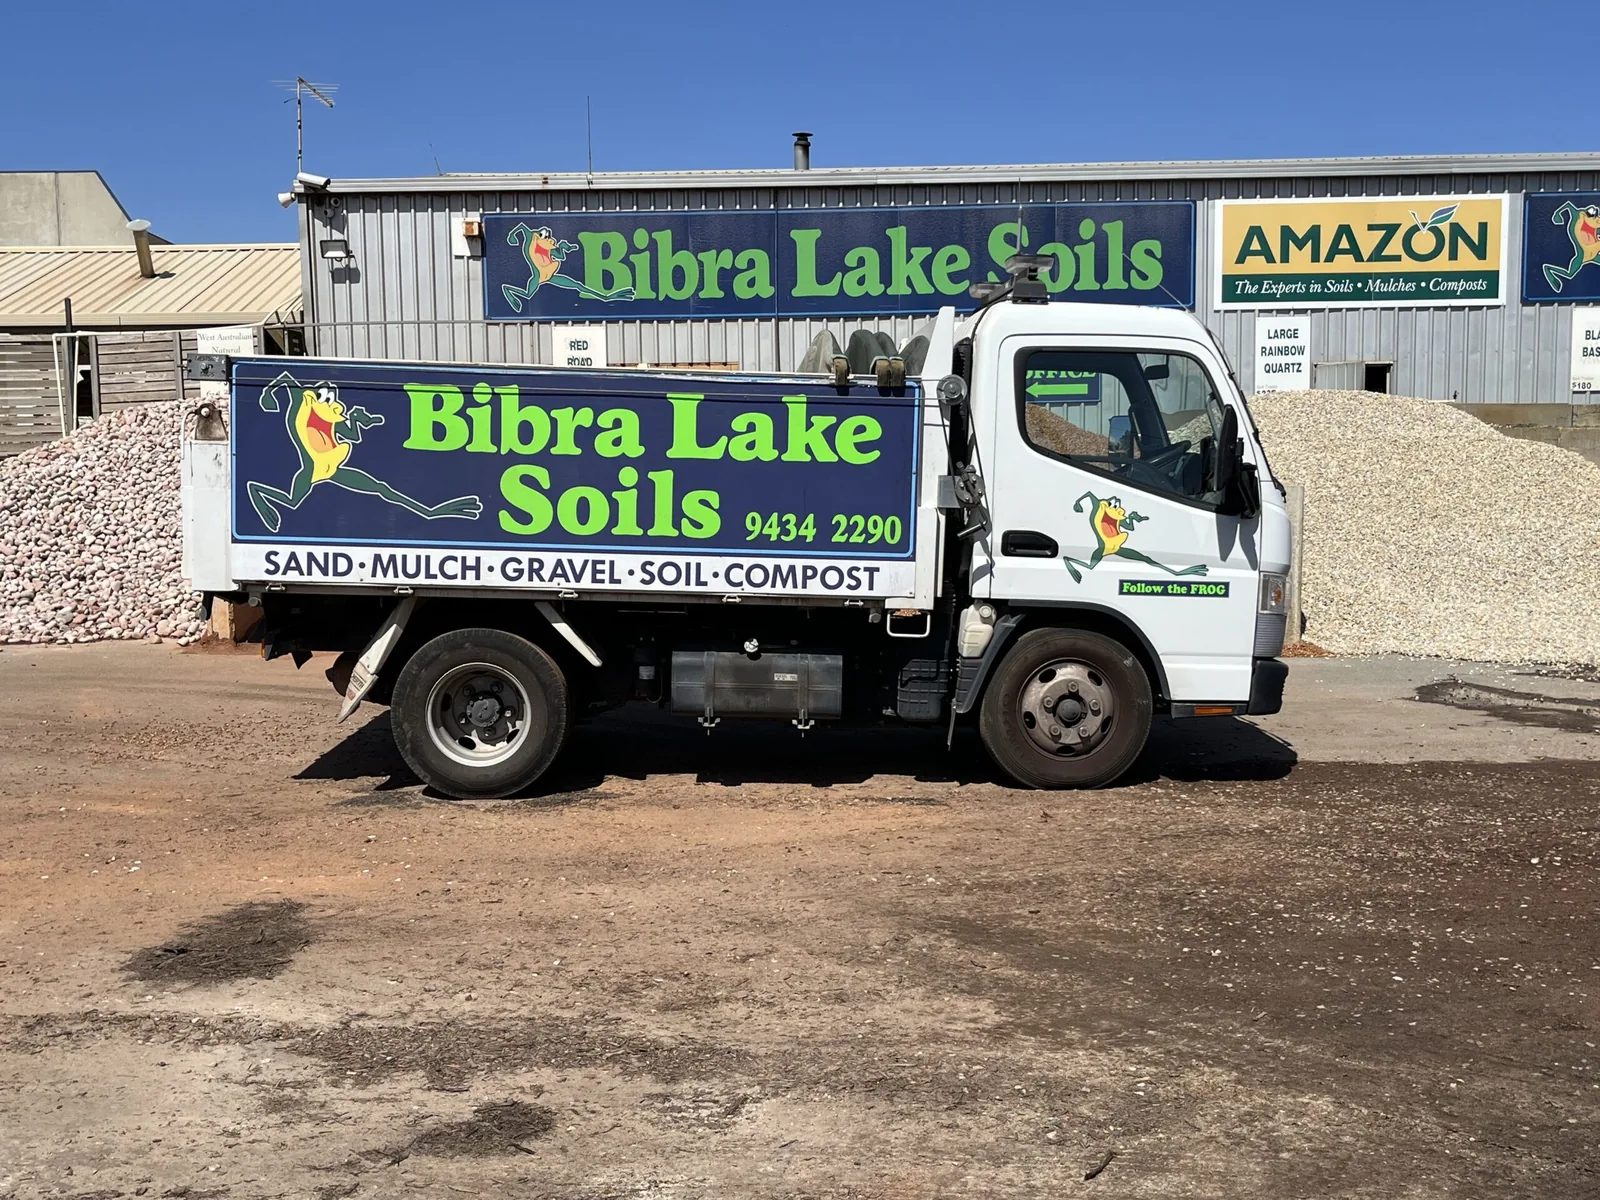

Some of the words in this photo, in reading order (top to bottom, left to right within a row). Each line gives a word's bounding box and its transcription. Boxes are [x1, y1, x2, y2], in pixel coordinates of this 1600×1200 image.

[1234, 221, 1488, 265] AMAZON
[578, 229, 775, 300] Bibra
[790, 226, 970, 297] Lake
[986, 219, 1164, 292] Soils
[1235, 281, 1259, 294] The
[1260, 280, 1307, 297] Experts
[1309, 281, 1322, 293] in
[1324, 279, 1354, 293] Soils
[1364, 278, 1417, 293] Mulches
[1429, 277, 1488, 297] Composts
[198, 332, 215, 341] West
[217, 332, 252, 341] Australian
[1267, 328, 1299, 340] LARGE
[211, 346, 241, 354] Natural
[569, 340, 589, 351] RED
[1260, 345, 1306, 357] RAINBOW
[567, 357, 593, 367] ROAD
[1264, 362, 1303, 374] QUARTZ
[1571, 381, 1592, 390] $180
[403, 382, 646, 457] Bibra
[666, 392, 883, 465] Lake
[498, 464, 722, 539] Soils
[745, 511, 817, 543] 9434
[831, 514, 902, 545] 2290
[264, 550, 354, 578] SAND
[370, 553, 482, 582] MULCH
[500, 556, 622, 586] GRAVEL
[640, 560, 710, 588] SOIL
[725, 562, 880, 592] COMPOST
[1122, 582, 1163, 593] Follow
[1167, 583, 1188, 594] the
[1190, 583, 1226, 595] FROG
